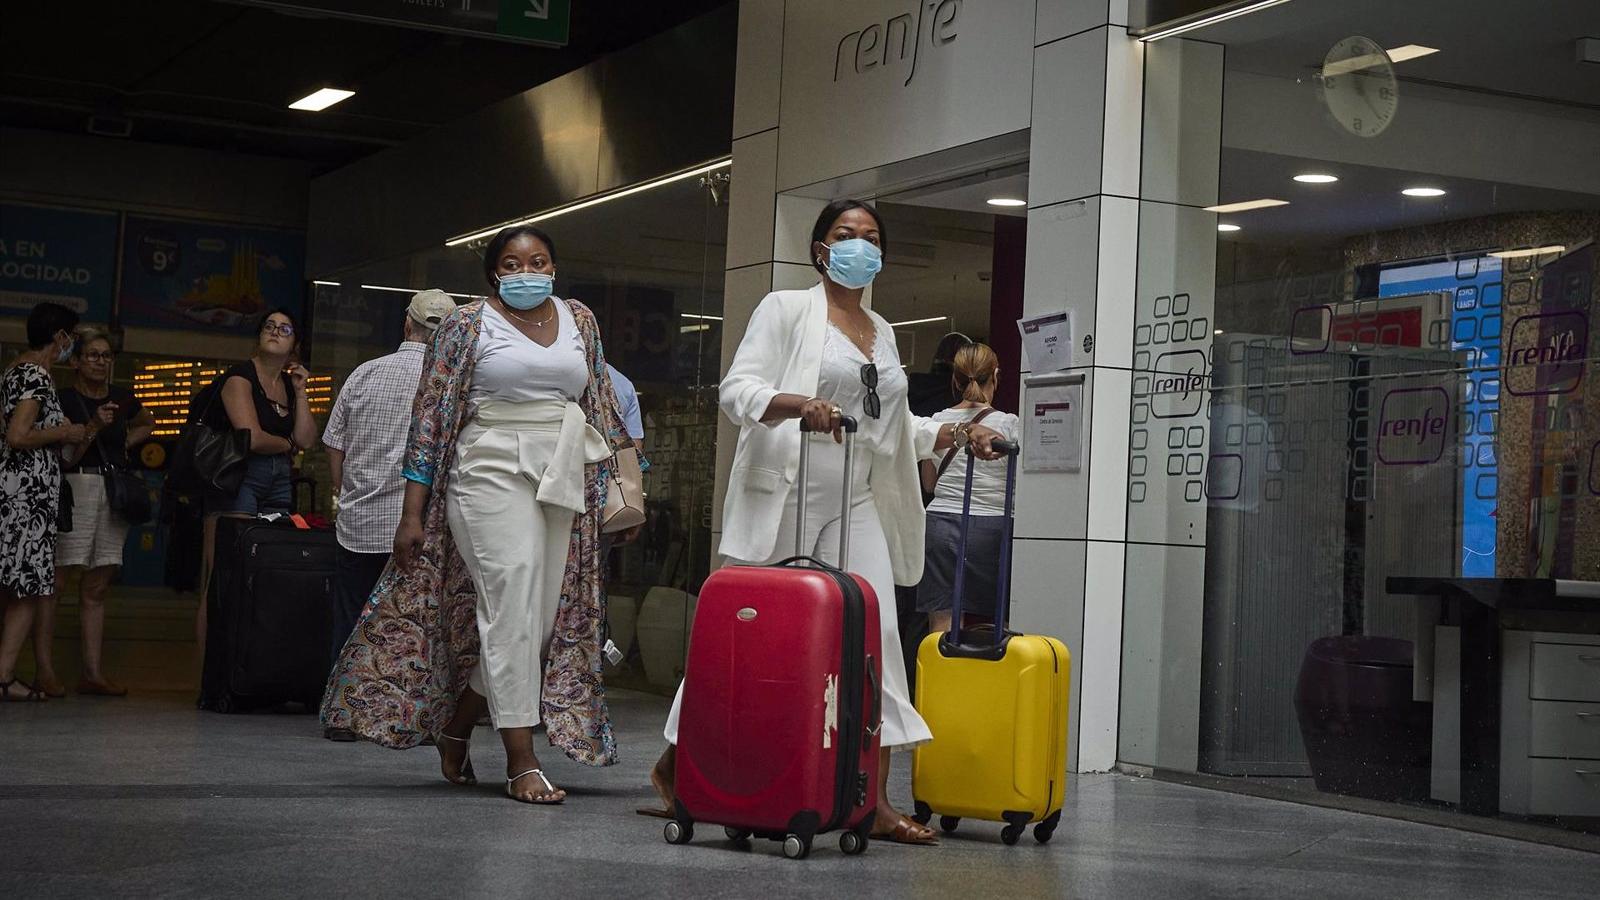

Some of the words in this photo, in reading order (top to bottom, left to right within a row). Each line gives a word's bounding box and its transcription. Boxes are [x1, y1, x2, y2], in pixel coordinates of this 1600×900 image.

[833, 0, 963, 87] renfe
[16, 240, 46, 258] EN
[0, 261, 91, 285] OCIDAD
[1156, 366, 1203, 401] renfe
[1382, 407, 1444, 445] renfe
